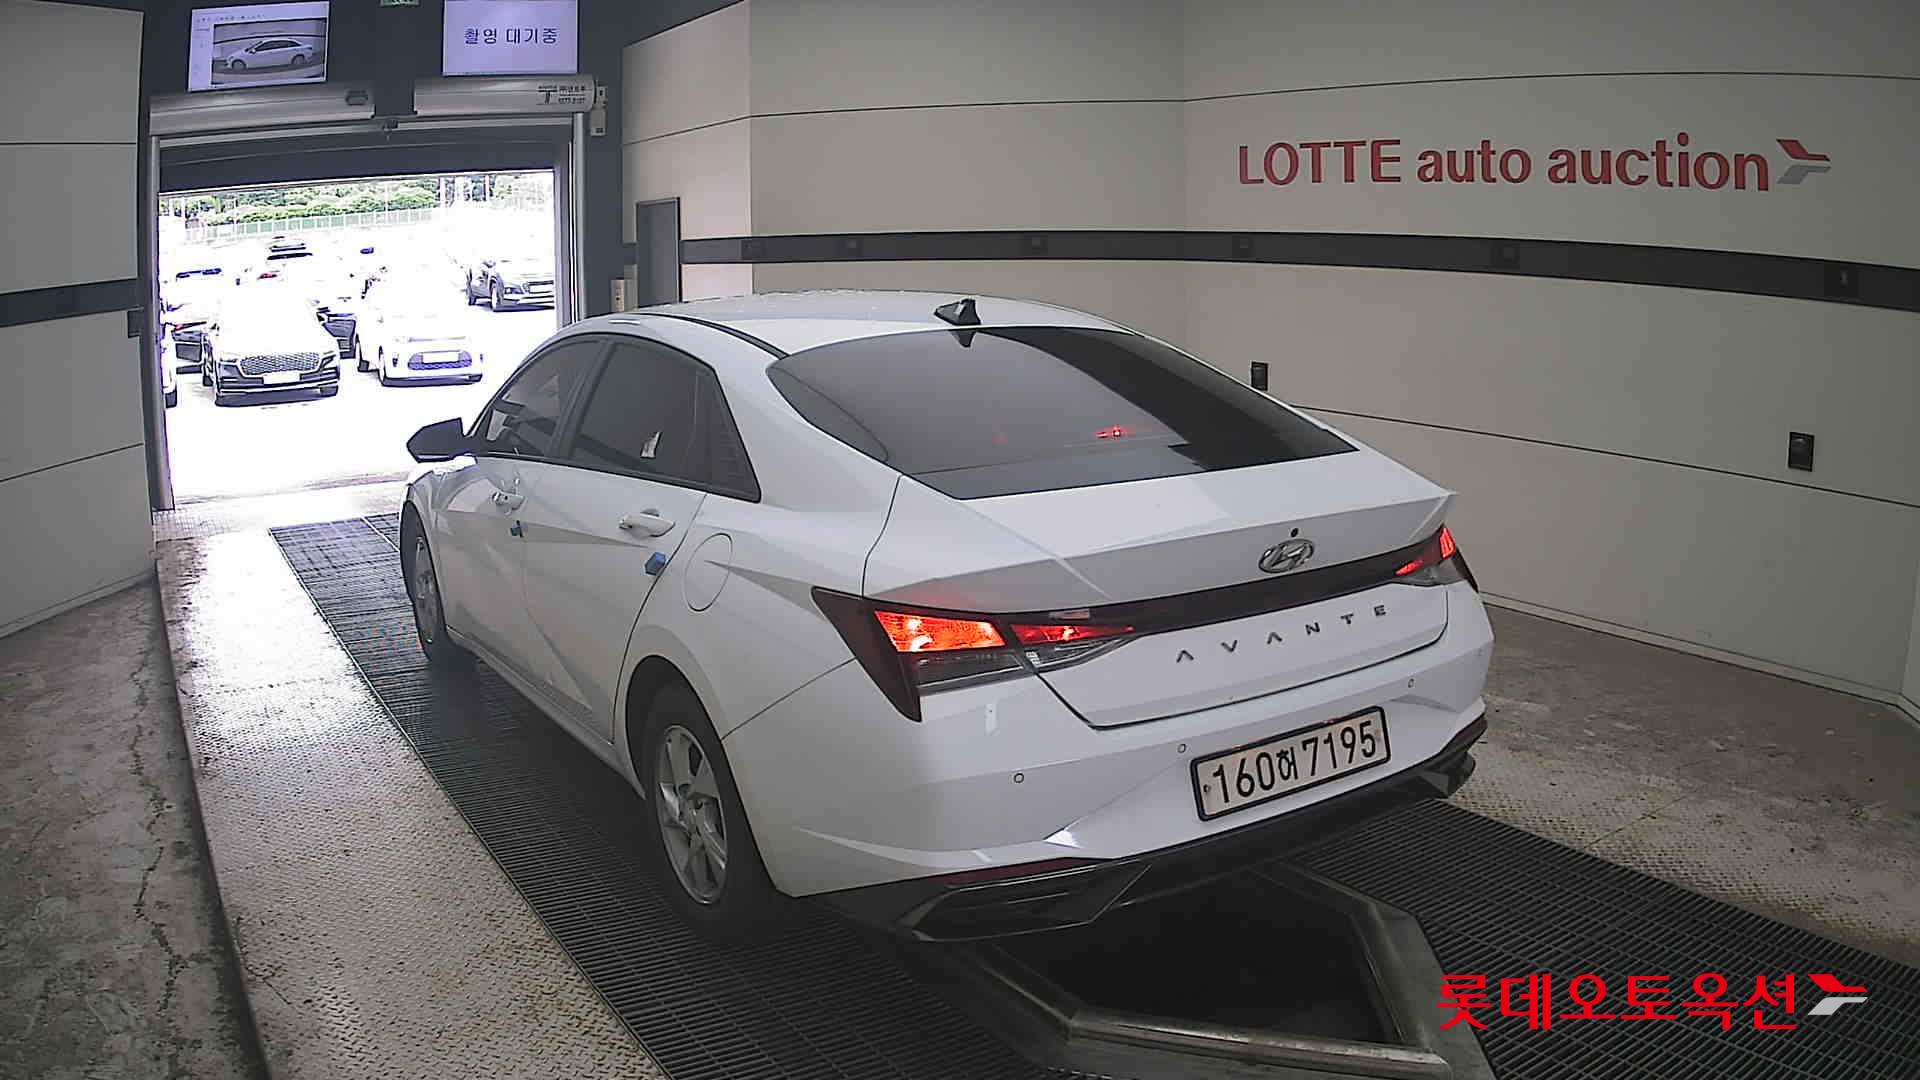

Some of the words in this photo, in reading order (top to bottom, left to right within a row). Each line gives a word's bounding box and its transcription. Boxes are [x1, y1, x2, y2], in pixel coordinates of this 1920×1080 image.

[464, 28, 497, 45] 촬영
[506, 28, 558, 45] 대기중
[1239, 139, 1401, 186] LOTTE
[1417, 138, 1532, 185] auto
[1548, 131, 1768, 192] auction
[1176, 604, 1387, 663] AVANTE
